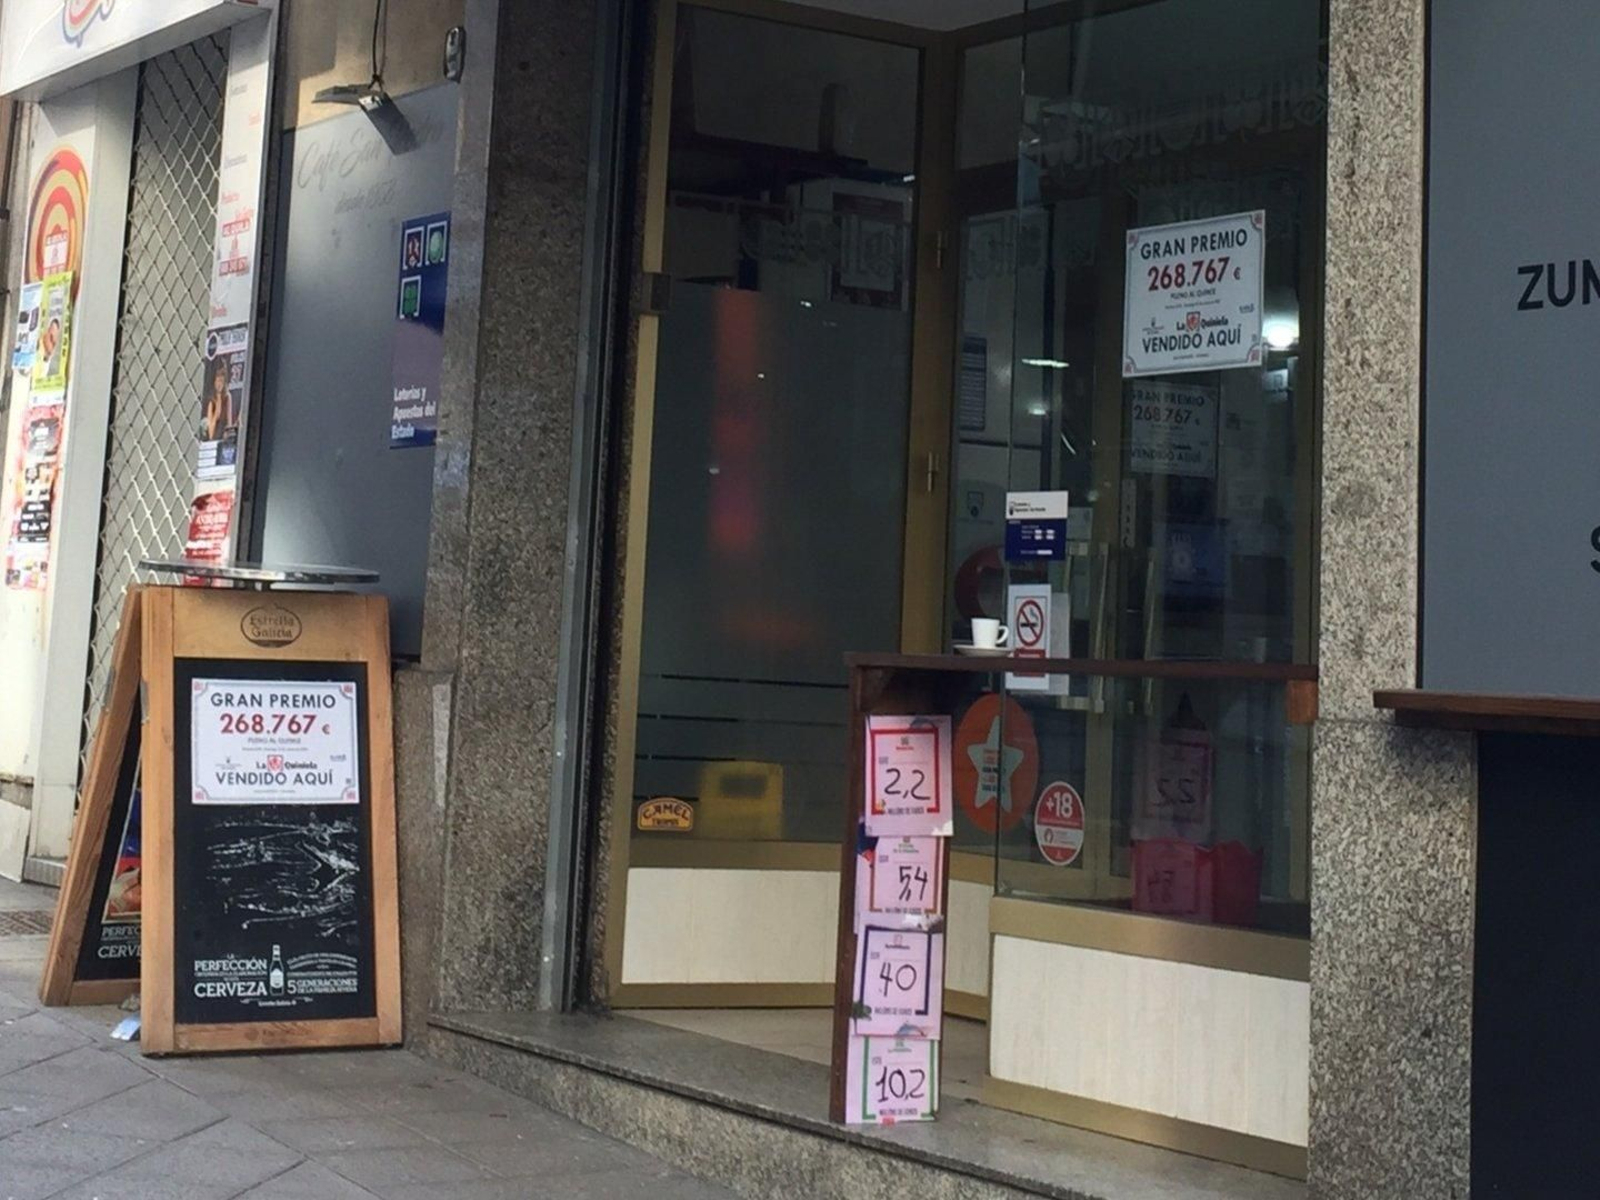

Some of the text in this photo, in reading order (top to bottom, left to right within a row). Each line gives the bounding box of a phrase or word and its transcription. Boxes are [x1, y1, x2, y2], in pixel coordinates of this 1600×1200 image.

[1140, 227, 1248, 261] GRAN PREMIO
[1147, 255, 1242, 292] 268.767 €
[1142, 323, 1241, 354] VENDIDO AQUÍ
[424, 401, 436, 417] del
[391, 422, 415, 440] Estado
[210, 692, 336, 709] GRAN PREMIO
[219, 713, 331, 735] 268.767 €
[215, 768, 334, 786] VENDIDO AQUÍ
[884, 767, 931, 801] 2,2
[642, 802, 690, 821] CAMEL
[1045, 791, 1073, 819] +18
[193, 955, 268, 972] PERFECCIÓN
[193, 980, 269, 998] CERVEZA
[286, 979, 298, 995] 5
[879, 961, 917, 997] 40
[875, 1065, 926, 1103] 10,2
